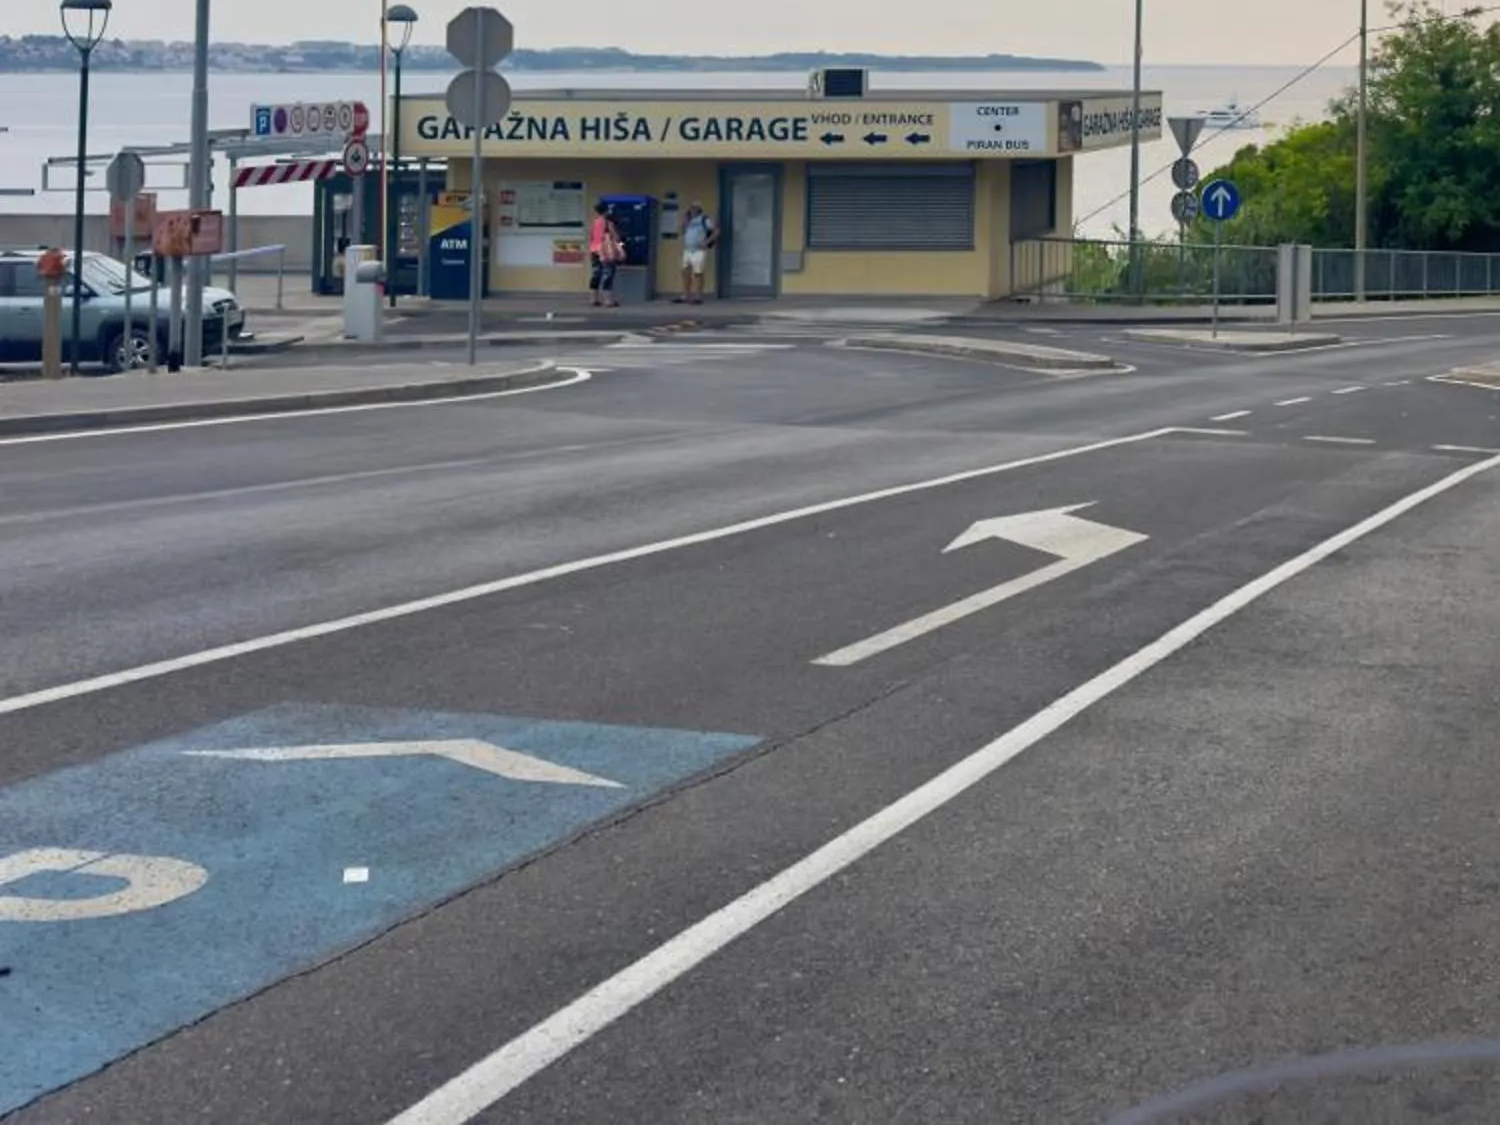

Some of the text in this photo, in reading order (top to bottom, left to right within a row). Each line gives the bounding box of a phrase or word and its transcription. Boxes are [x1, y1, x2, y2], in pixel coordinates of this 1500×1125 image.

[976, 106, 1020, 117] CENTER
[811, 114, 850, 126] VHOD
[863, 113, 935, 126] ENTRANCE
[580, 110, 652, 141] HIŠA
[679, 116, 809, 142] GARAGE
[441, 238, 468, 250] ATM
